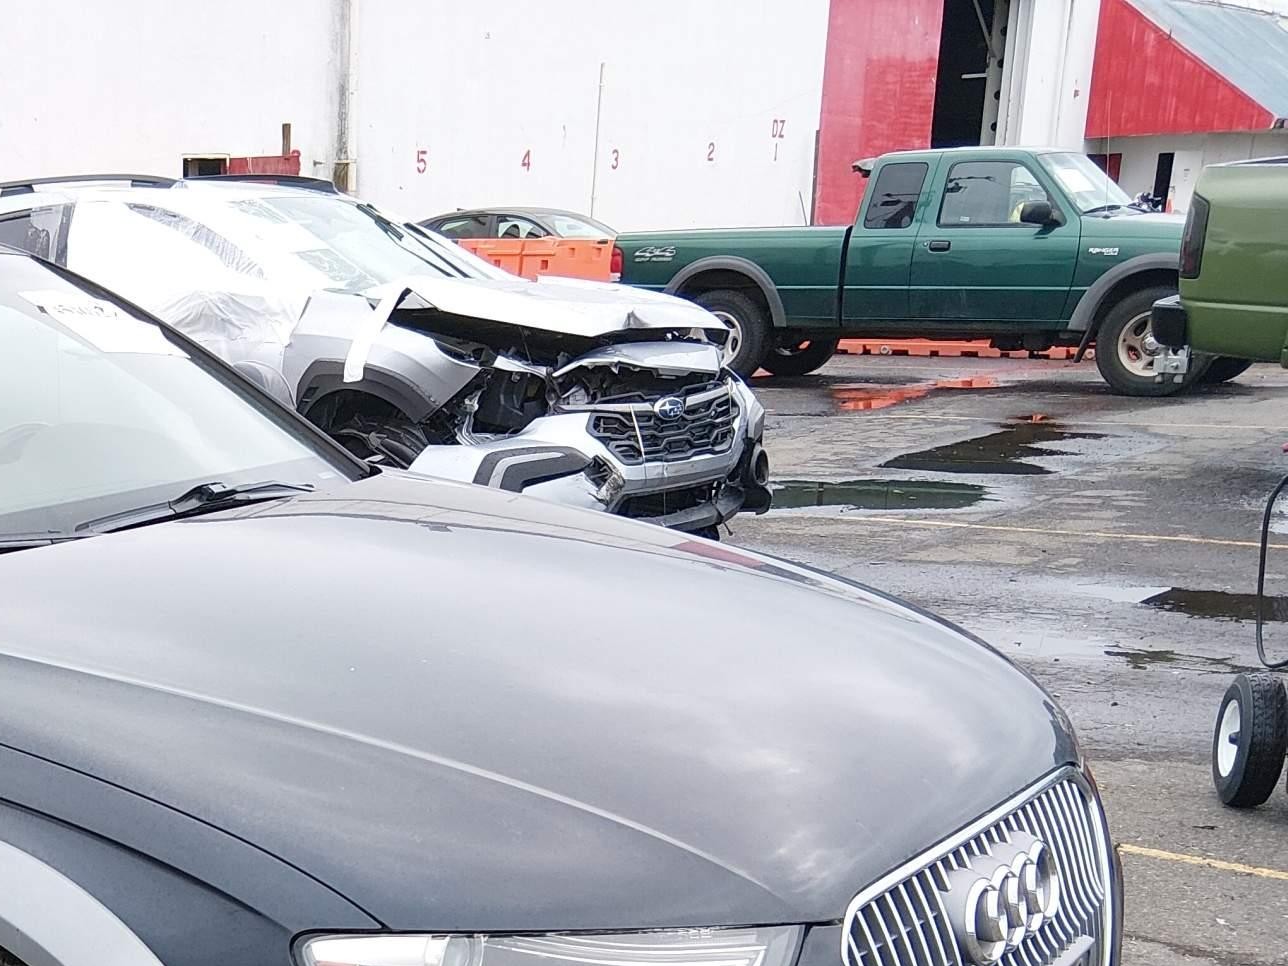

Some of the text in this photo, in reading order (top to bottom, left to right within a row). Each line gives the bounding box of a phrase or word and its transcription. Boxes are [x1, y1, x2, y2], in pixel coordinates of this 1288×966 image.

[772, 118, 786, 139] DZ
[416, 149, 428, 174] 5
[521, 149, 531, 172] 4
[611, 149, 619, 170] 3
[707, 142, 715, 162] 2
